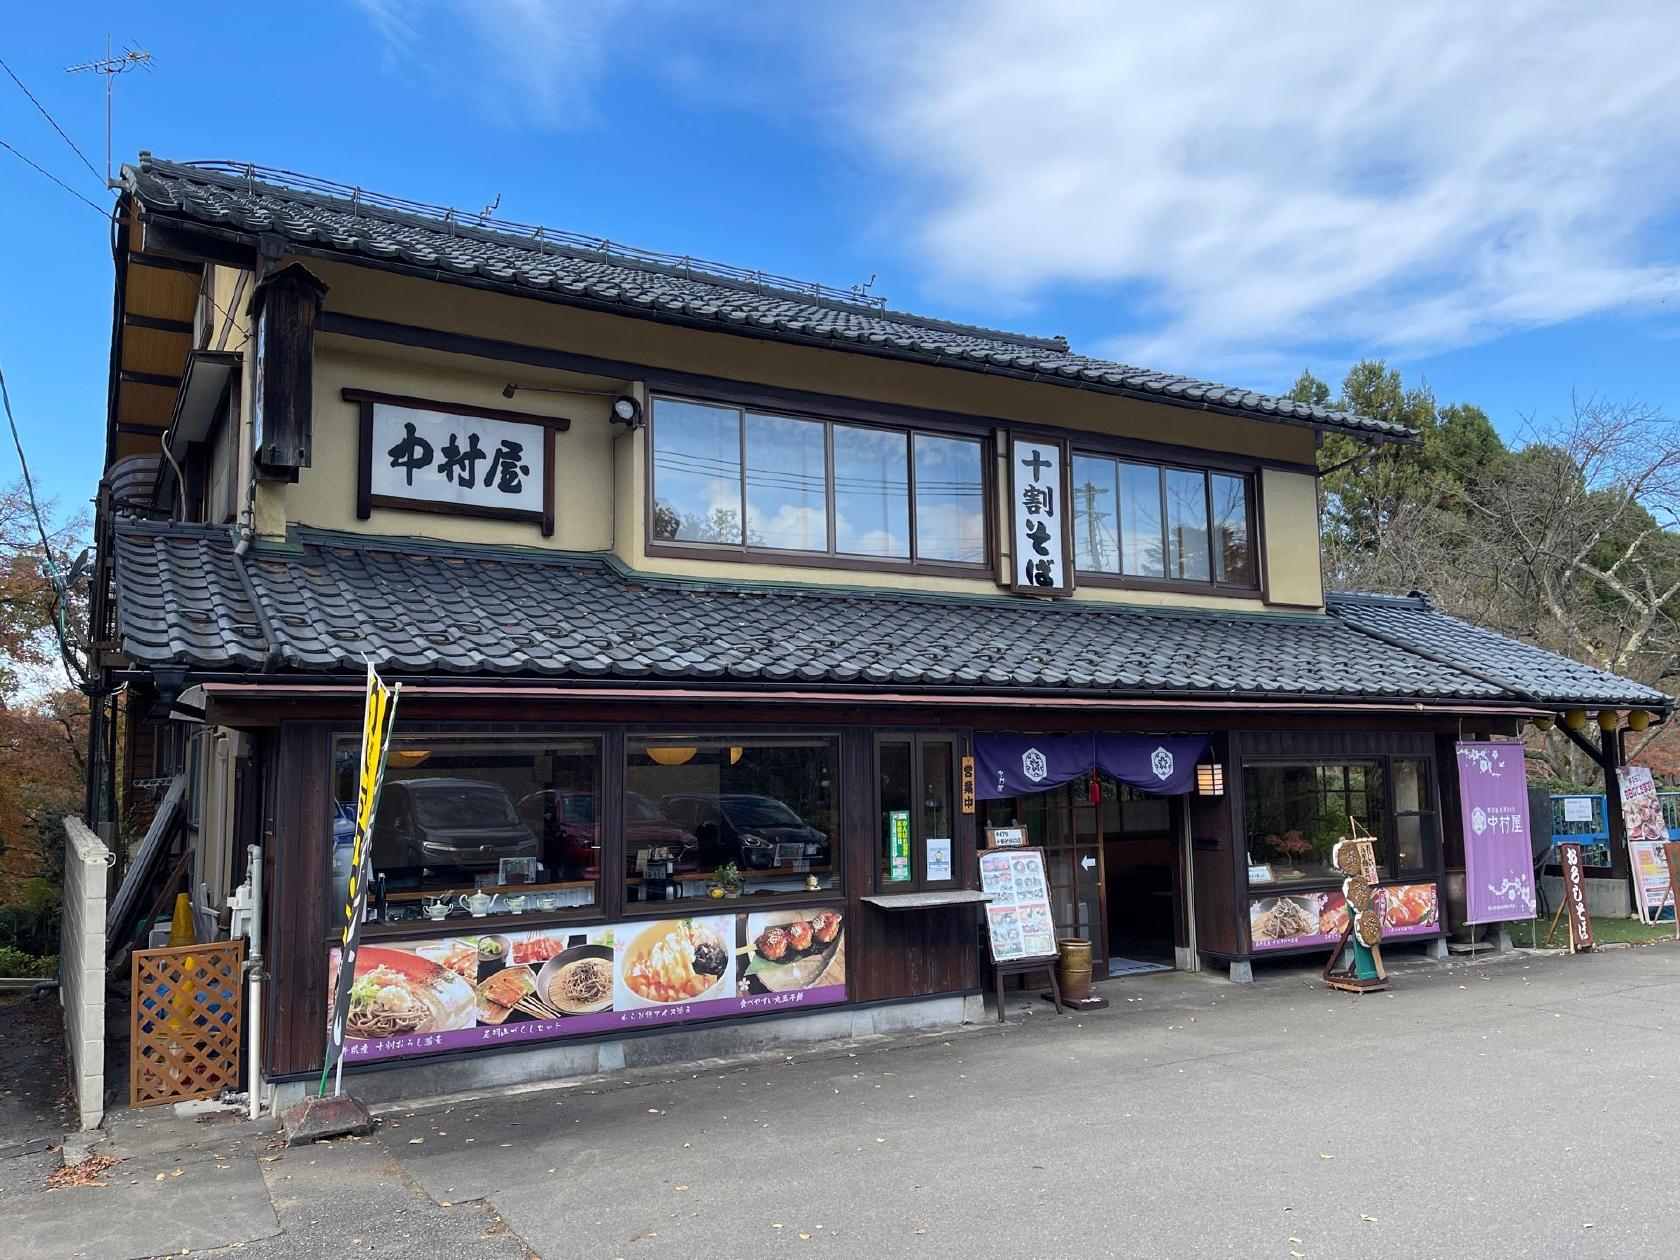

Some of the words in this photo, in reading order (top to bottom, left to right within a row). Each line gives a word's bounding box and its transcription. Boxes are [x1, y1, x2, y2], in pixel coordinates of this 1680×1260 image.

[387, 422, 530, 494] 中村屋
[1021, 449, 1055, 587] 十割そば
[963, 765, 973, 808] 営業中
[1487, 814, 1523, 834] 中村屋
[1566, 847, 1589, 940] おろしそば
